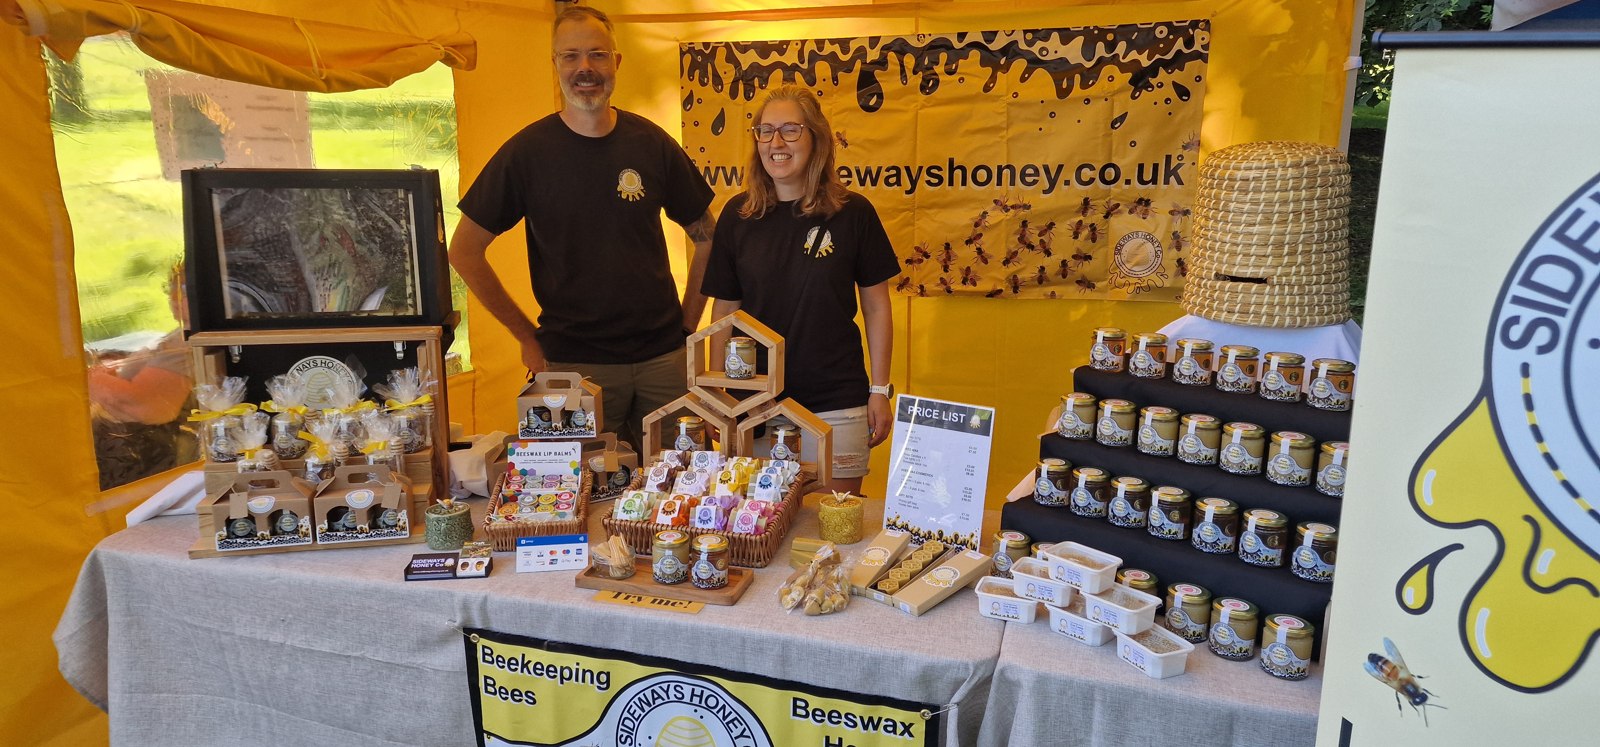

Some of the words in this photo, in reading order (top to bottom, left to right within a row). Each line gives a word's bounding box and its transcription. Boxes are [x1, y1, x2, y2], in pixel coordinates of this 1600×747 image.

[1115, 233, 1139, 256] SIDEWAYS
[1141, 233, 1161, 250] HONEY
[1500, 191, 1600, 355] SIDE
[907, 405, 939, 420] PRICE
[942, 411, 967, 424] LIST
[650, 598, 692, 609] me!
[481, 644, 611, 691] Beekeeping
[483, 675, 537, 705] Bees
[619, 683, 685, 747] SIDEWAYS
[689, 687, 752, 741] HONEY
[792, 696, 915, 738] Beeswax
